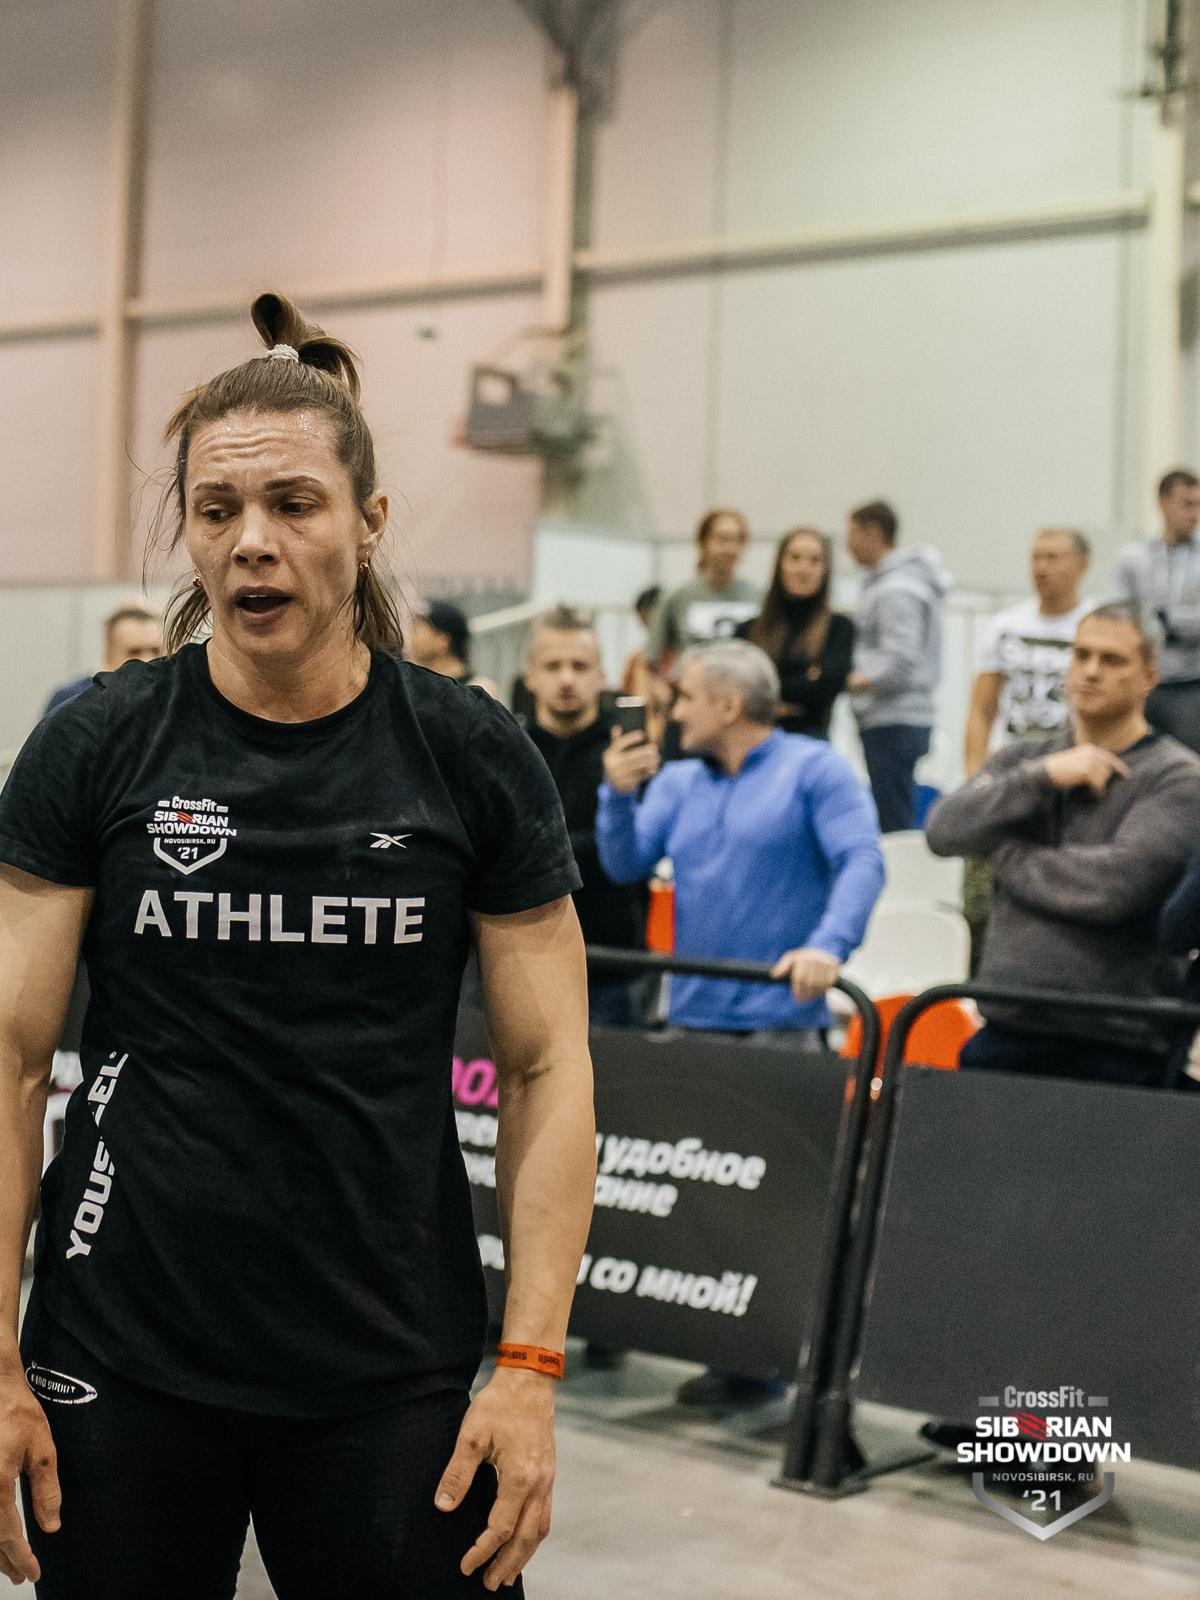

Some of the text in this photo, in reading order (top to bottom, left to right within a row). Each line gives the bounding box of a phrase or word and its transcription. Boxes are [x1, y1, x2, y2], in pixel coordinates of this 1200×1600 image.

[171, 796, 218, 812] CrossFit
[153, 810, 229, 827] SIBRIAN
[146, 822, 237, 836] SHOWDOWN
[177, 846, 199, 860] '21
[134, 889, 425, 945] ATHLETE
